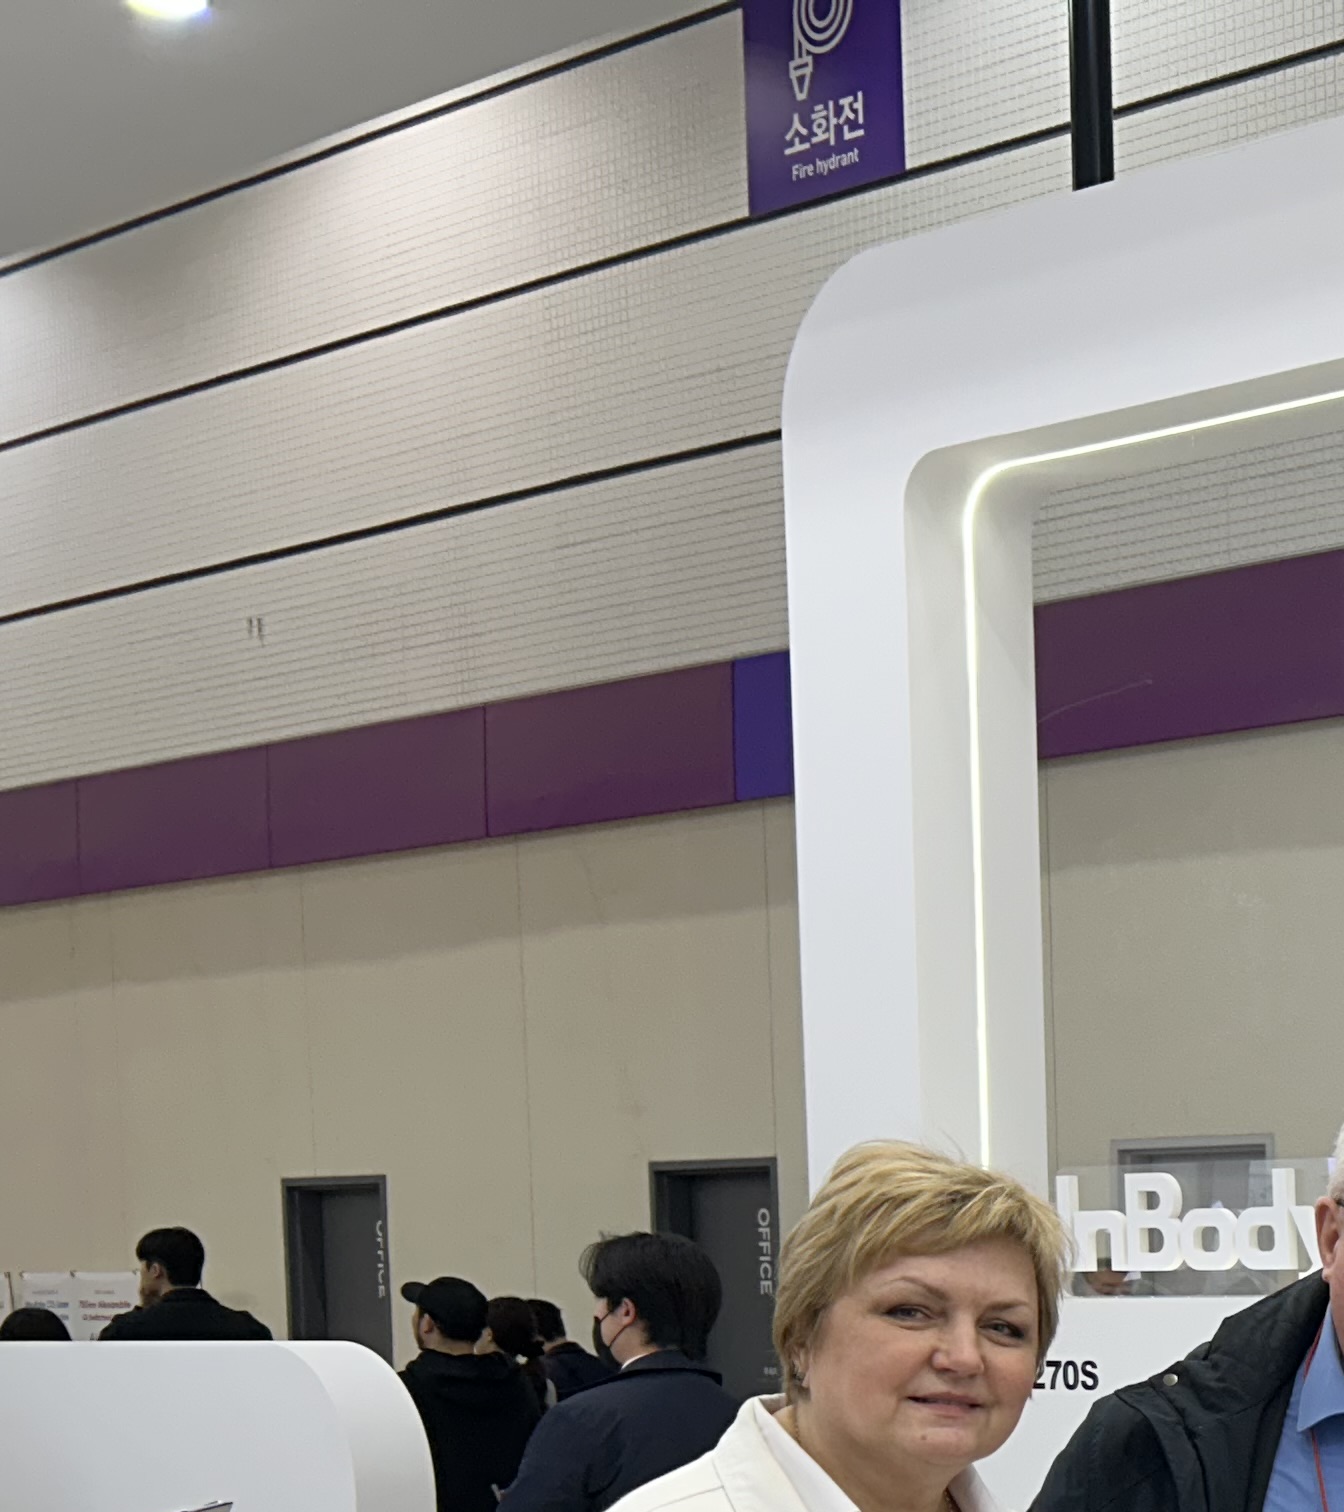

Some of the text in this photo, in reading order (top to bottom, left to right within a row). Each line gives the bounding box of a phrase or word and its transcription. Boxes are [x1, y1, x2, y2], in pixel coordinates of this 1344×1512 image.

[784, 91, 865, 156] 소화전
[791, 147, 859, 182] Fire hydrant
[757, 1208, 773, 1295] OFFICE
